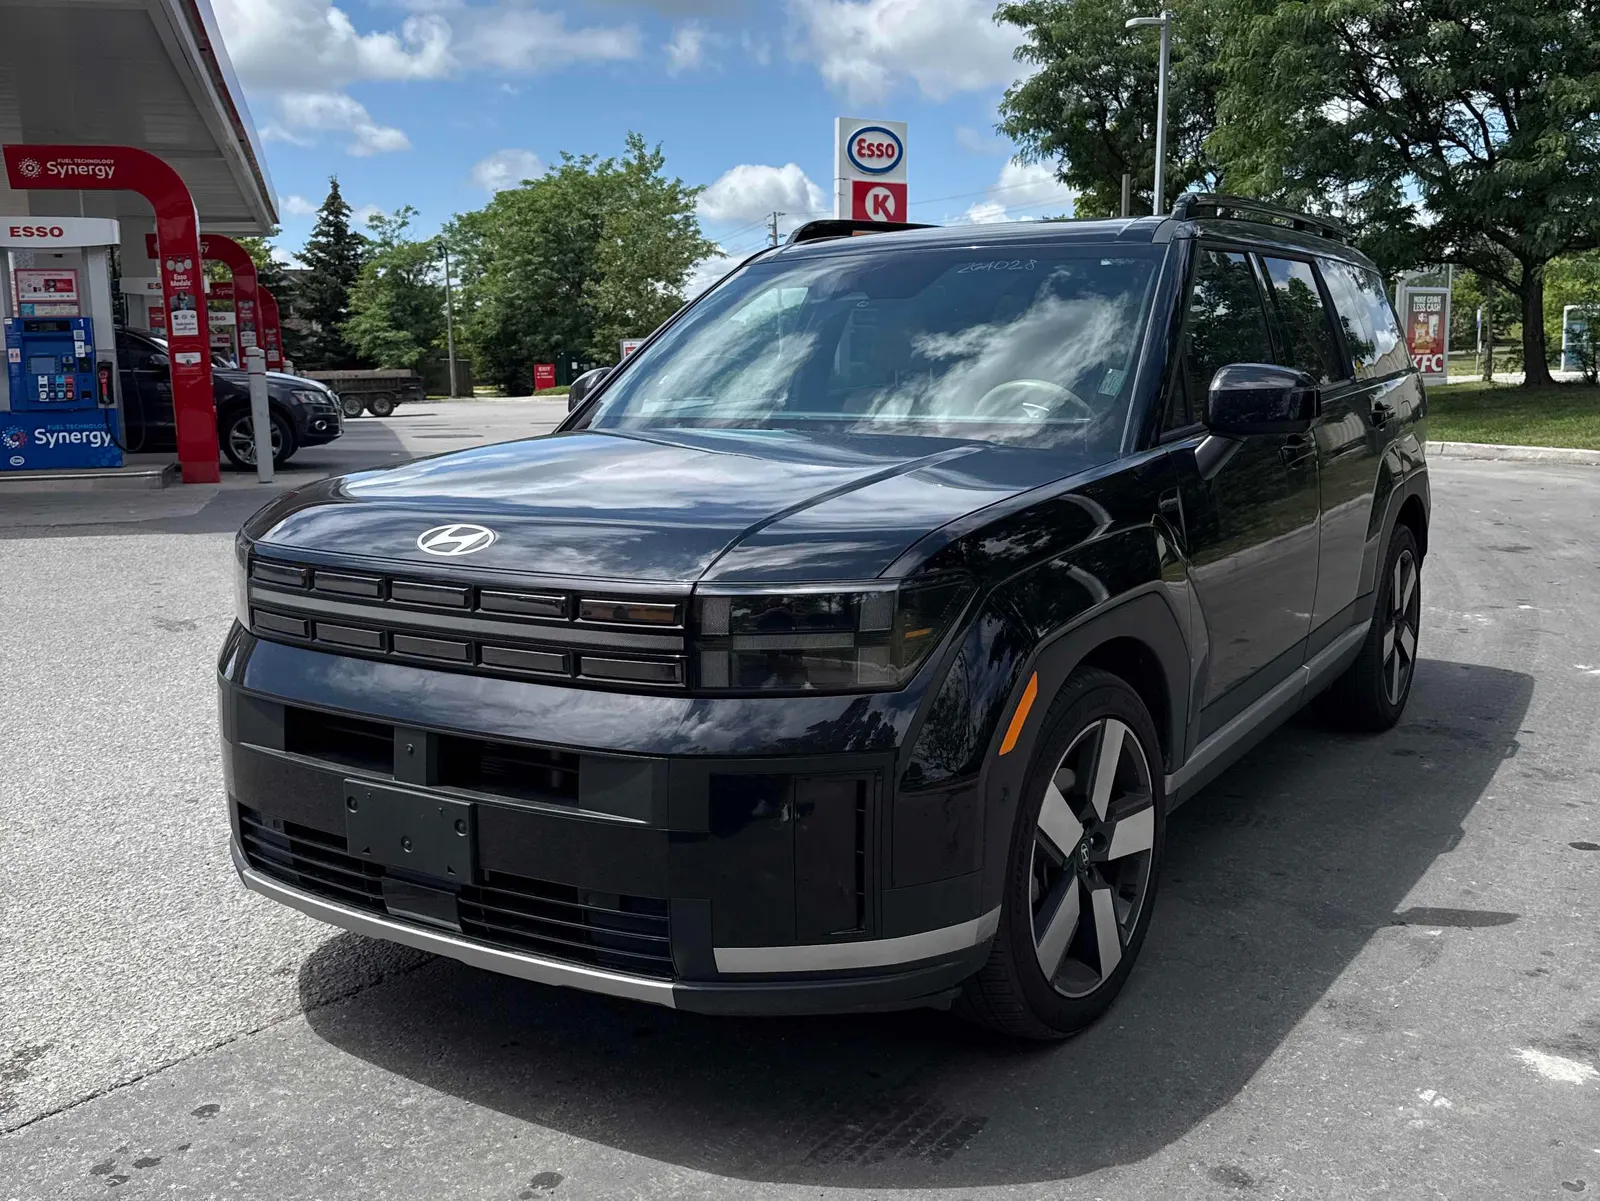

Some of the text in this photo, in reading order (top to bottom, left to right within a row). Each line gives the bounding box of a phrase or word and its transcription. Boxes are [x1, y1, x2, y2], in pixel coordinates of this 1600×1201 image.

[857, 138, 895, 158] Esso
[46, 161, 115, 179] Synergy
[9, 226, 64, 238] ESSO
[1413, 303, 1441, 311] LESS CASH
[79, 319, 84, 327] 1
[34, 428, 112, 448] Synergy
